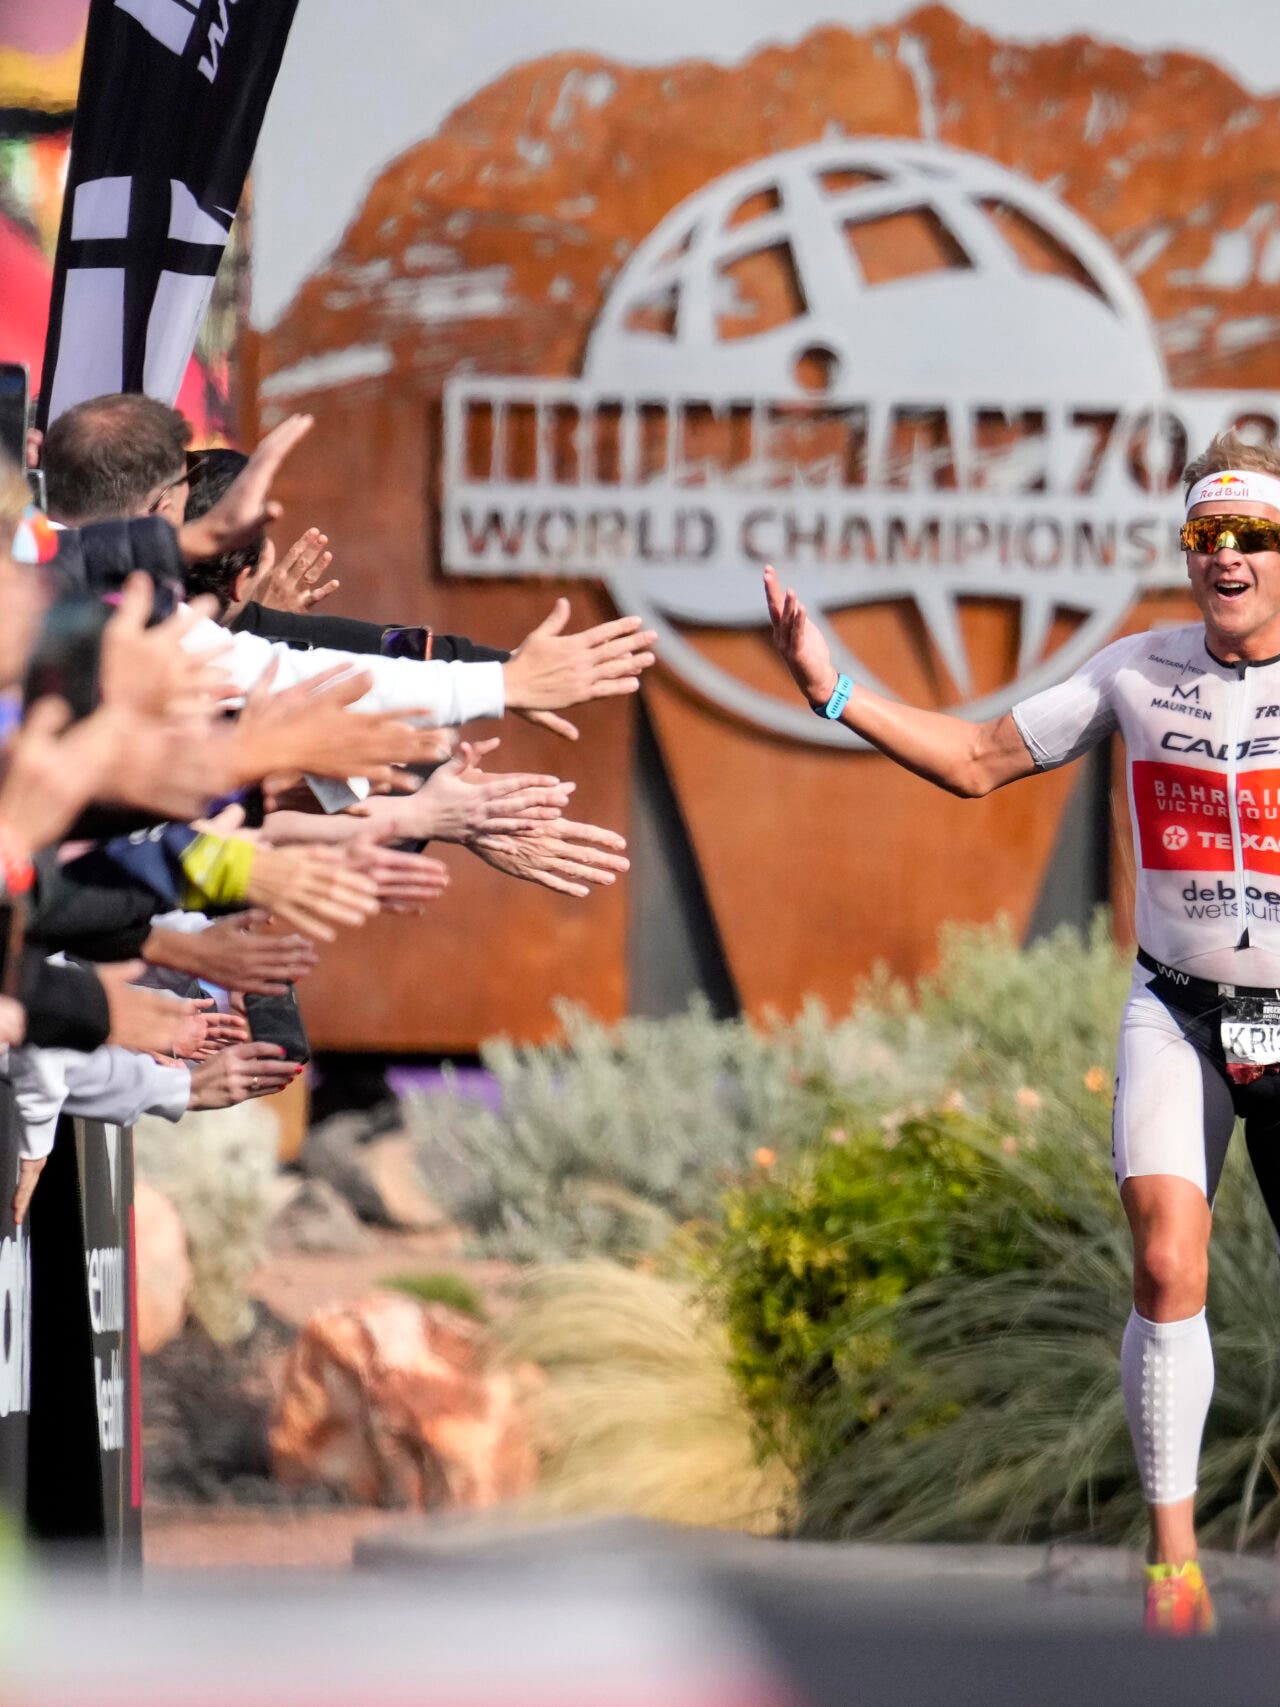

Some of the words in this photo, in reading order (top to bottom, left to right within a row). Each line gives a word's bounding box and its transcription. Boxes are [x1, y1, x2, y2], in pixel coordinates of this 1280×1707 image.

[1200, 489, 1223, 499] Red
[1224, 487, 1250, 497] Bull
[460, 506, 718, 561] WORLD
[738, 508, 1183, 571] CHAMPIONS
[1150, 697, 1213, 721] MAURTEN
